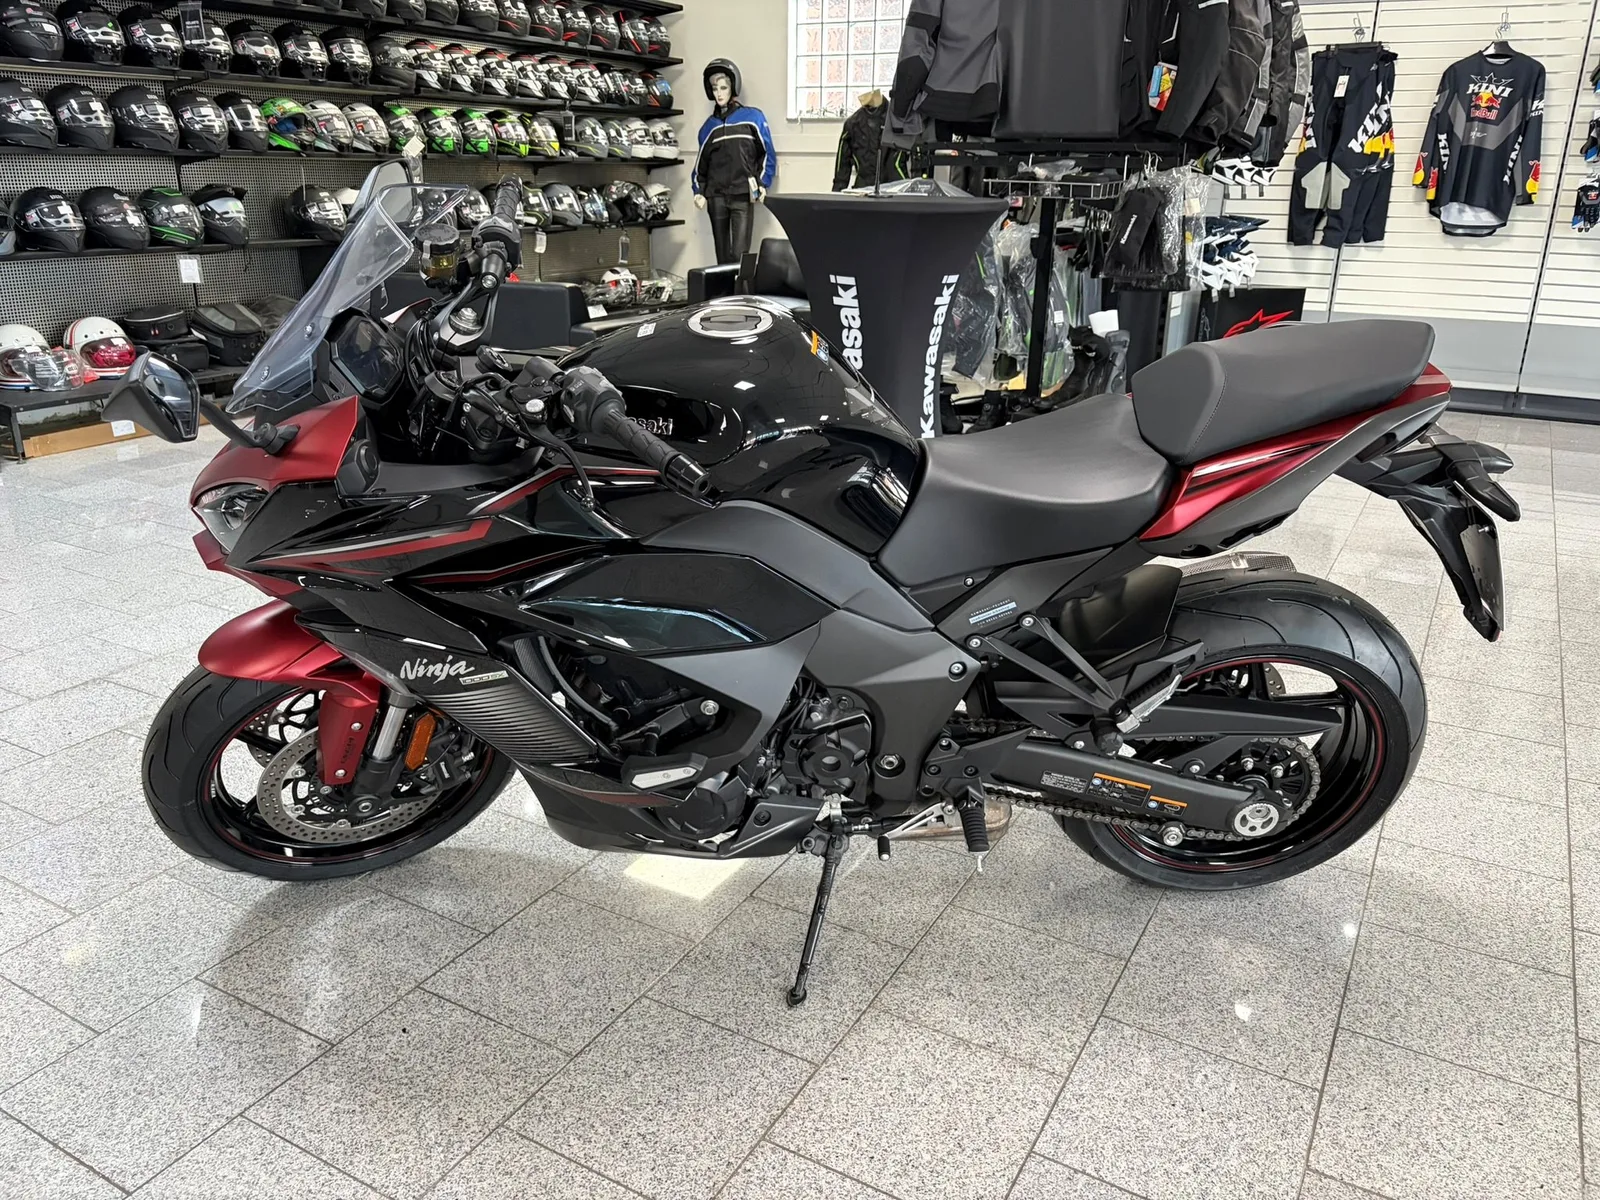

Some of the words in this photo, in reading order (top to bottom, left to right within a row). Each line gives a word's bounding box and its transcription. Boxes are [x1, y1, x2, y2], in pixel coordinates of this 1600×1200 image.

[1466, 82, 1513, 97] KINI
[920, 274, 960, 439] Kawasaki
[400, 654, 475, 685] Ninja
